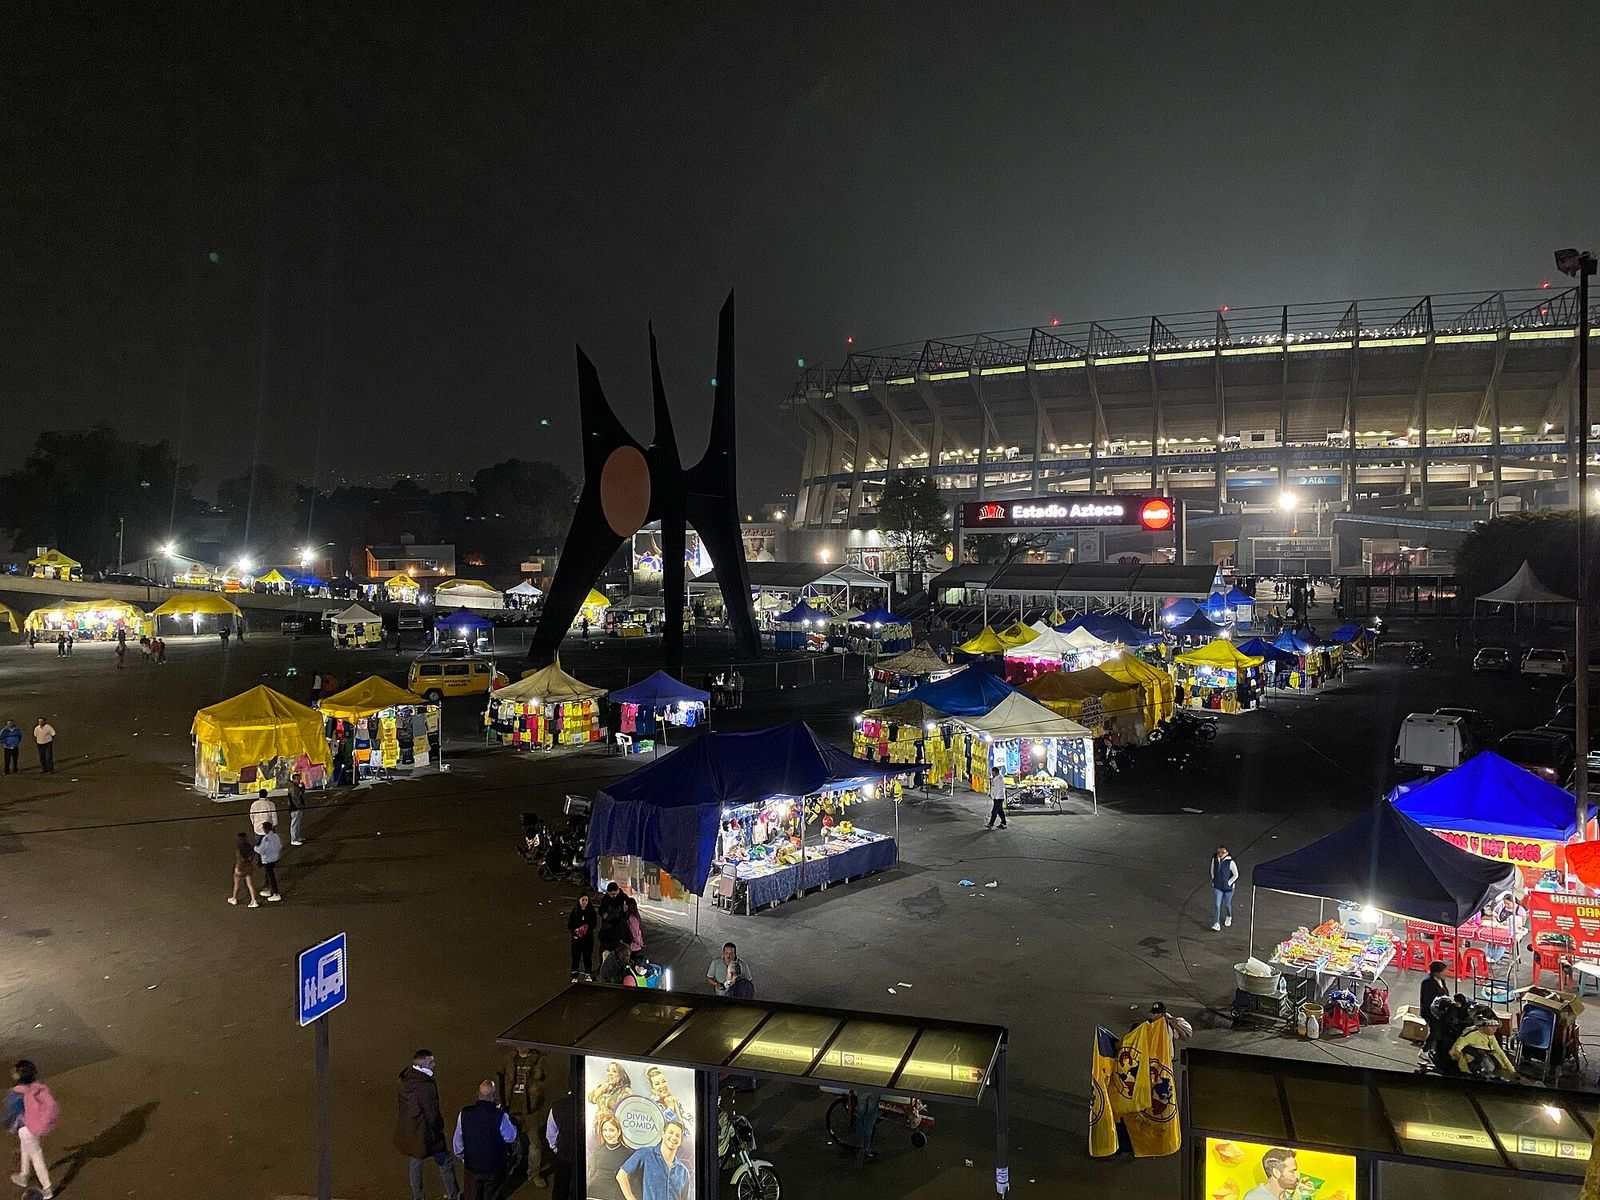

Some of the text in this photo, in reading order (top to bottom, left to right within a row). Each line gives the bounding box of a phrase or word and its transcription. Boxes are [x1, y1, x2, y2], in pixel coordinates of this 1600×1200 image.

[1308, 476, 1327, 485] AT&T
[1012, 503, 1124, 518] Estadio Azteca
[1481, 838, 1505, 858] HOT
[1507, 841, 1542, 863] DOGS
[626, 1112, 655, 1123] DIVINA
[622, 1119, 658, 1131] COMIDA
